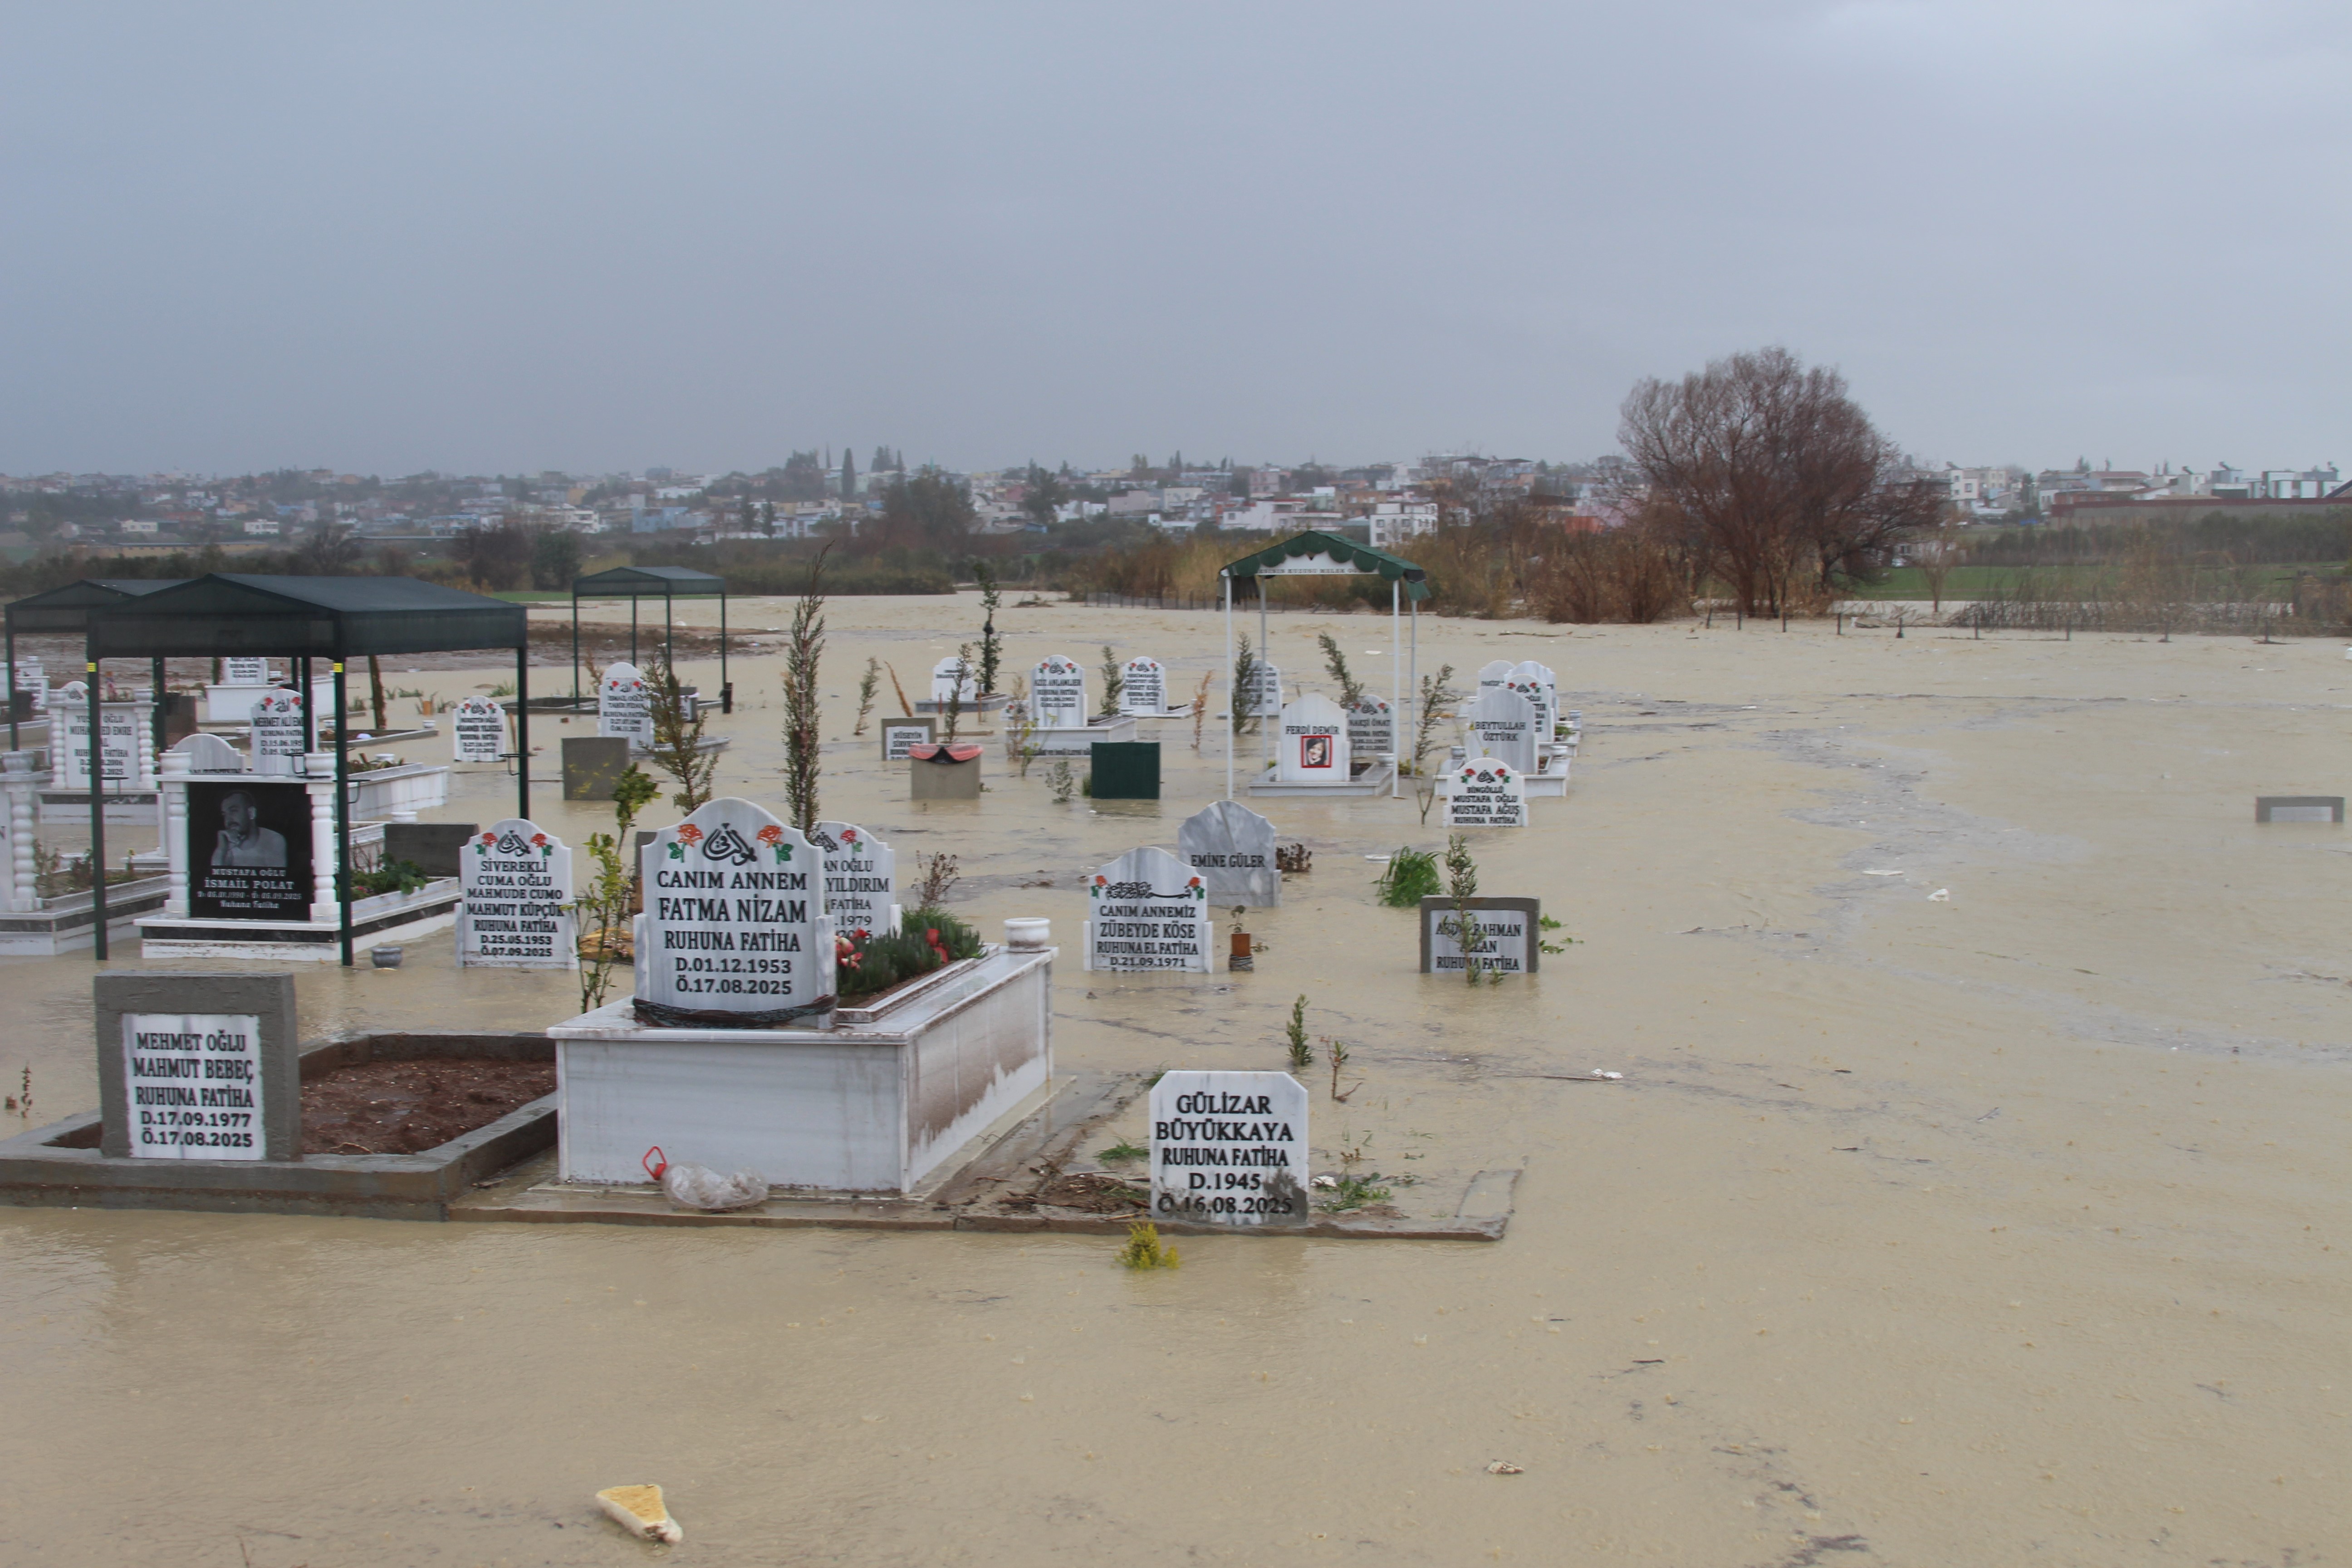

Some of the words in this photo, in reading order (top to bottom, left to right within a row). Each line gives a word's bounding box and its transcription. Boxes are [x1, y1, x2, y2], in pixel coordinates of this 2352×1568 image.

[1285, 725, 1311, 735] FERDİ
[1312, 725, 1340, 735] DEMİR
[1475, 721, 1526, 730] BEYTULLAH
[1483, 731, 1519, 741] ÖZTÜRK
[1495, 794, 1518, 803] OĞLU
[1451, 805, 1492, 814] MUSTAFA
[1489, 815, 1517, 823] FATİHA
[480, 858, 548, 872] SİVEREKLİ
[841, 858, 873, 872] OĞLU
[1191, 852, 1226, 867] EMİNE
[1229, 852, 1265, 867] GÜLER
[259, 867, 286, 877] OĞLU
[477, 876, 514, 886] CUMA
[517, 873, 553, 886] OĞLU
[204, 877, 249, 888] İSMAİL
[253, 880, 294, 889] POLAT
[656, 870, 725, 890] CANIM
[730, 872, 808, 891] ANNEM
[825, 877, 890, 892] YILDIRIM
[466, 888, 527, 898] MAHMUDE
[529, 889, 563, 899] CUMO
[466, 903, 517, 916] MAHMUT
[658, 897, 731, 921] FATMA
[736, 894, 807, 923] NİZAM
[830, 897, 872, 909] FATİHA
[1100, 905, 1137, 917] CANIM
[1141, 904, 1196, 917] ANNEMİZ
[473, 919, 517, 931] RUHUNA
[519, 918, 559, 933] FATİHA
[1100, 919, 1159, 938] ZÜBEYDE
[1162, 920, 1196, 938] KÖSE
[480, 934, 553, 945] D.25.05.1953
[664, 930, 735, 951] RUHUNA
[740, 929, 801, 952] FATİHA
[480, 945, 553, 957] Ö.07.09.2025
[1158, 940, 1199, 955] FATİHA
[675, 957, 792, 974] D.01.12.1953
[1110, 956, 1186, 967] D.21.09.1971
[1482, 955, 1520, 970] FATİHA
[676, 975, 792, 995] Ö.17.08.2025
[136, 1032, 202, 1051] MEHMET
[206, 1029, 246, 1052] OĞLU
[132, 1057, 201, 1078] MAHMUT
[205, 1058, 255, 1084] BEBEÇ
[135, 1086, 198, 1107] RUHUNA
[200, 1084, 255, 1107] FATİHA
[1176, 1091, 1273, 1114] GÜLİZAR
[140, 1111, 251, 1127] D.17.09.1977
[142, 1127, 253, 1147] Ö.17.08.2025
[1155, 1117, 1294, 1142] BÜYÜKKAYA
[1162, 1147, 1228, 1166] RUHUNA
[1231, 1145, 1289, 1166] FATİHA
[1189, 1172, 1262, 1190] D.1945
[1158, 1192, 1294, 1214] Ö.16.08.2025
